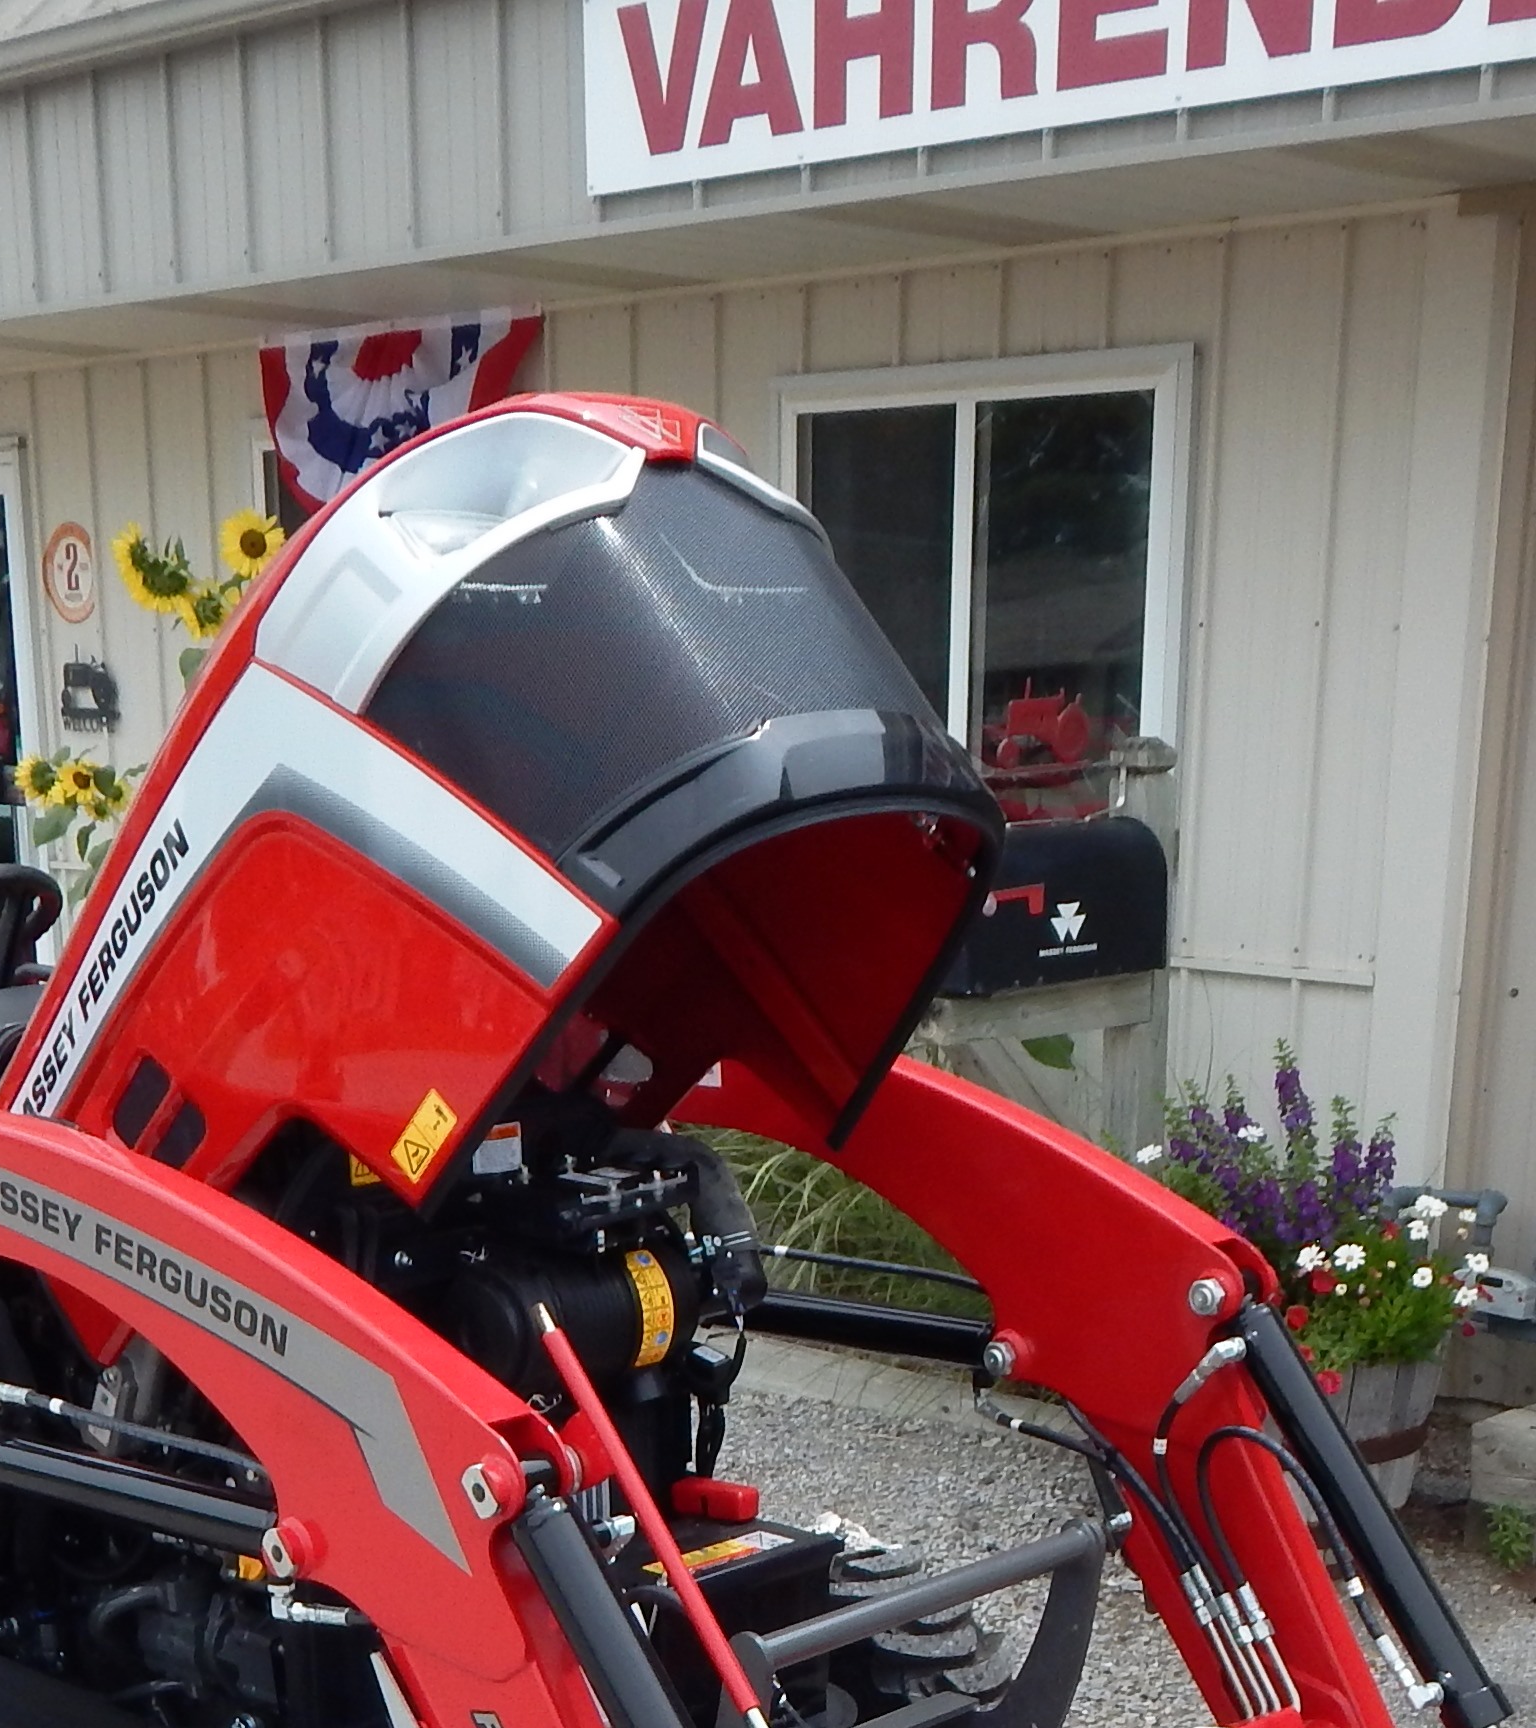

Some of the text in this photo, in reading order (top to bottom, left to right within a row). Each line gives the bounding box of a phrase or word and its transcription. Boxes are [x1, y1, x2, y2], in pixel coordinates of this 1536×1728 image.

[65, 543, 80, 591] 2
[78, 818, 190, 1024] FERGUSON
[94, 1223, 289, 1357] FERGUSON
